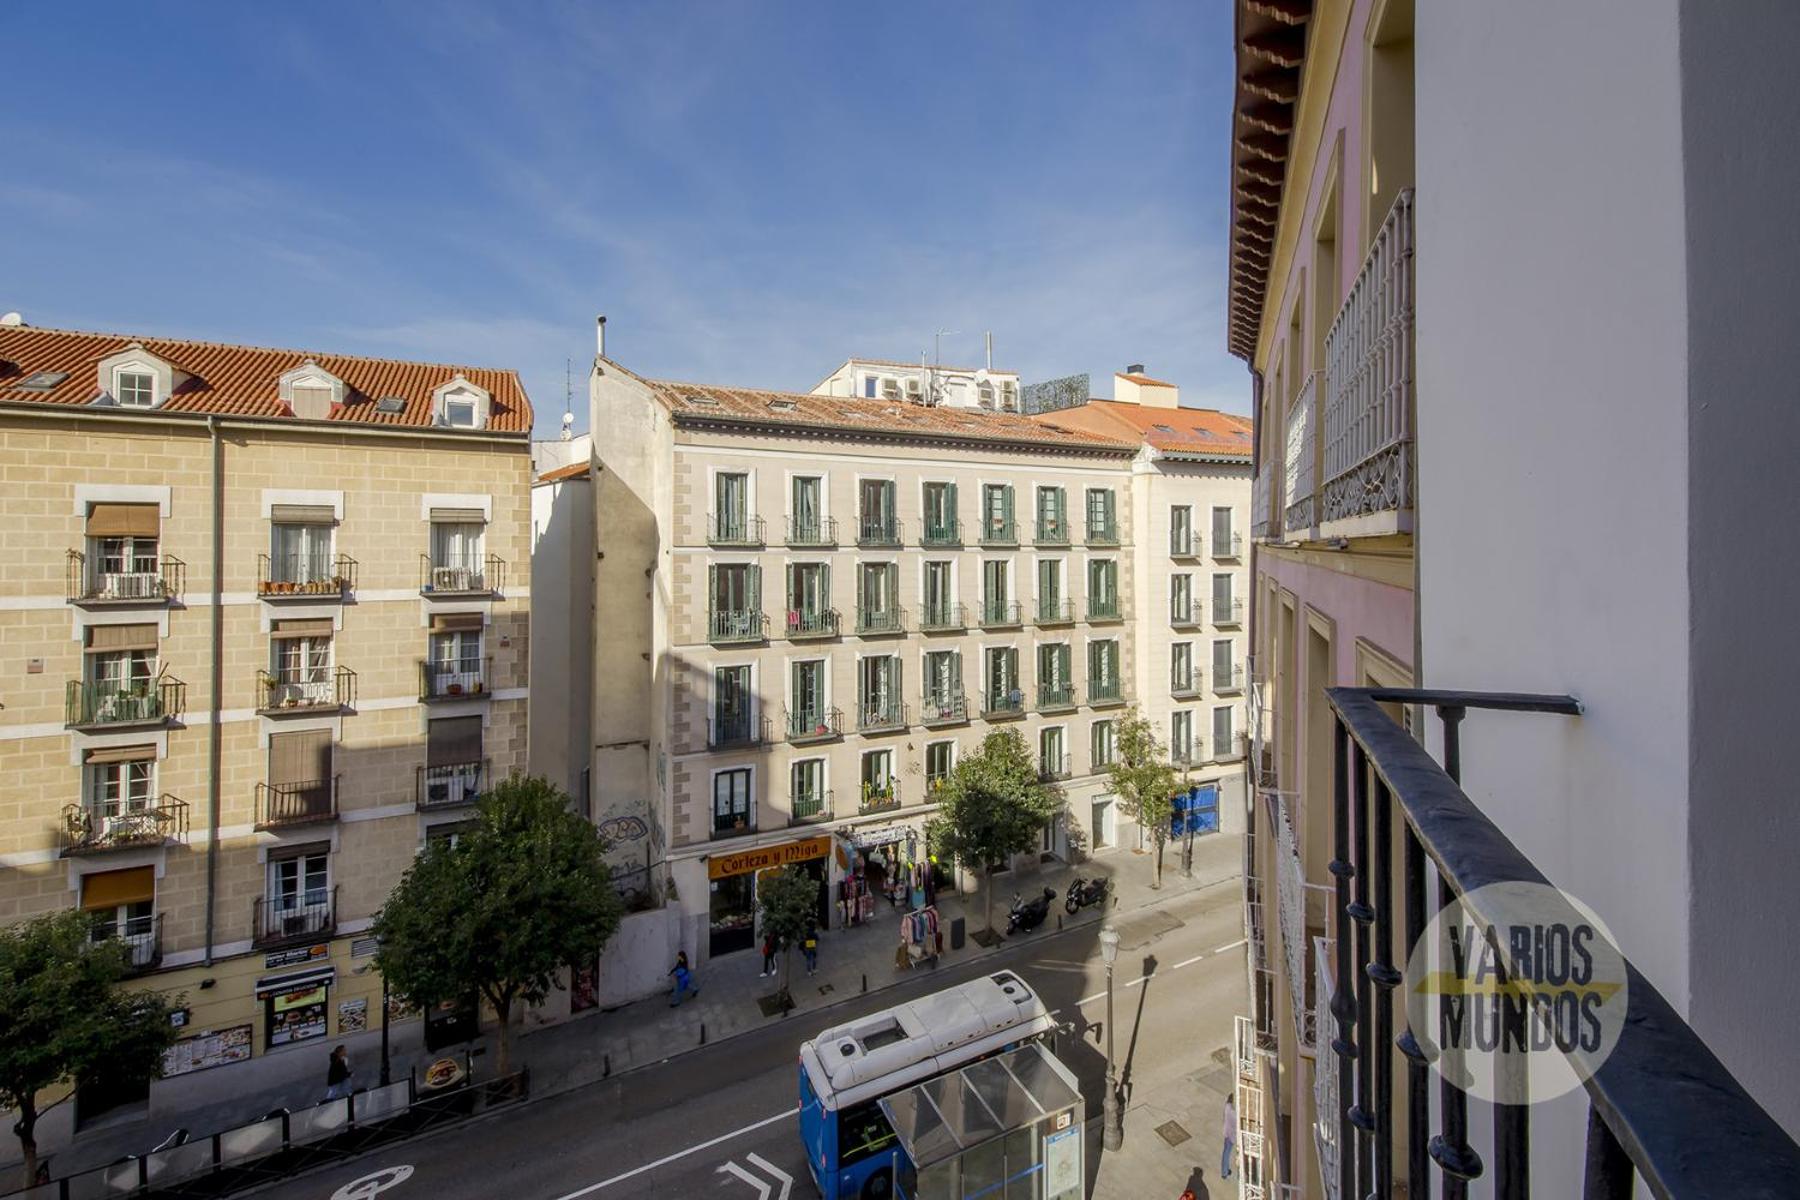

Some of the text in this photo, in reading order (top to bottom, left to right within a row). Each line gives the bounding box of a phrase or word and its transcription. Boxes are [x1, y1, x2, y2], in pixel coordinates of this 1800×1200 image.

[721, 844, 818, 874] Corteza y Miga
